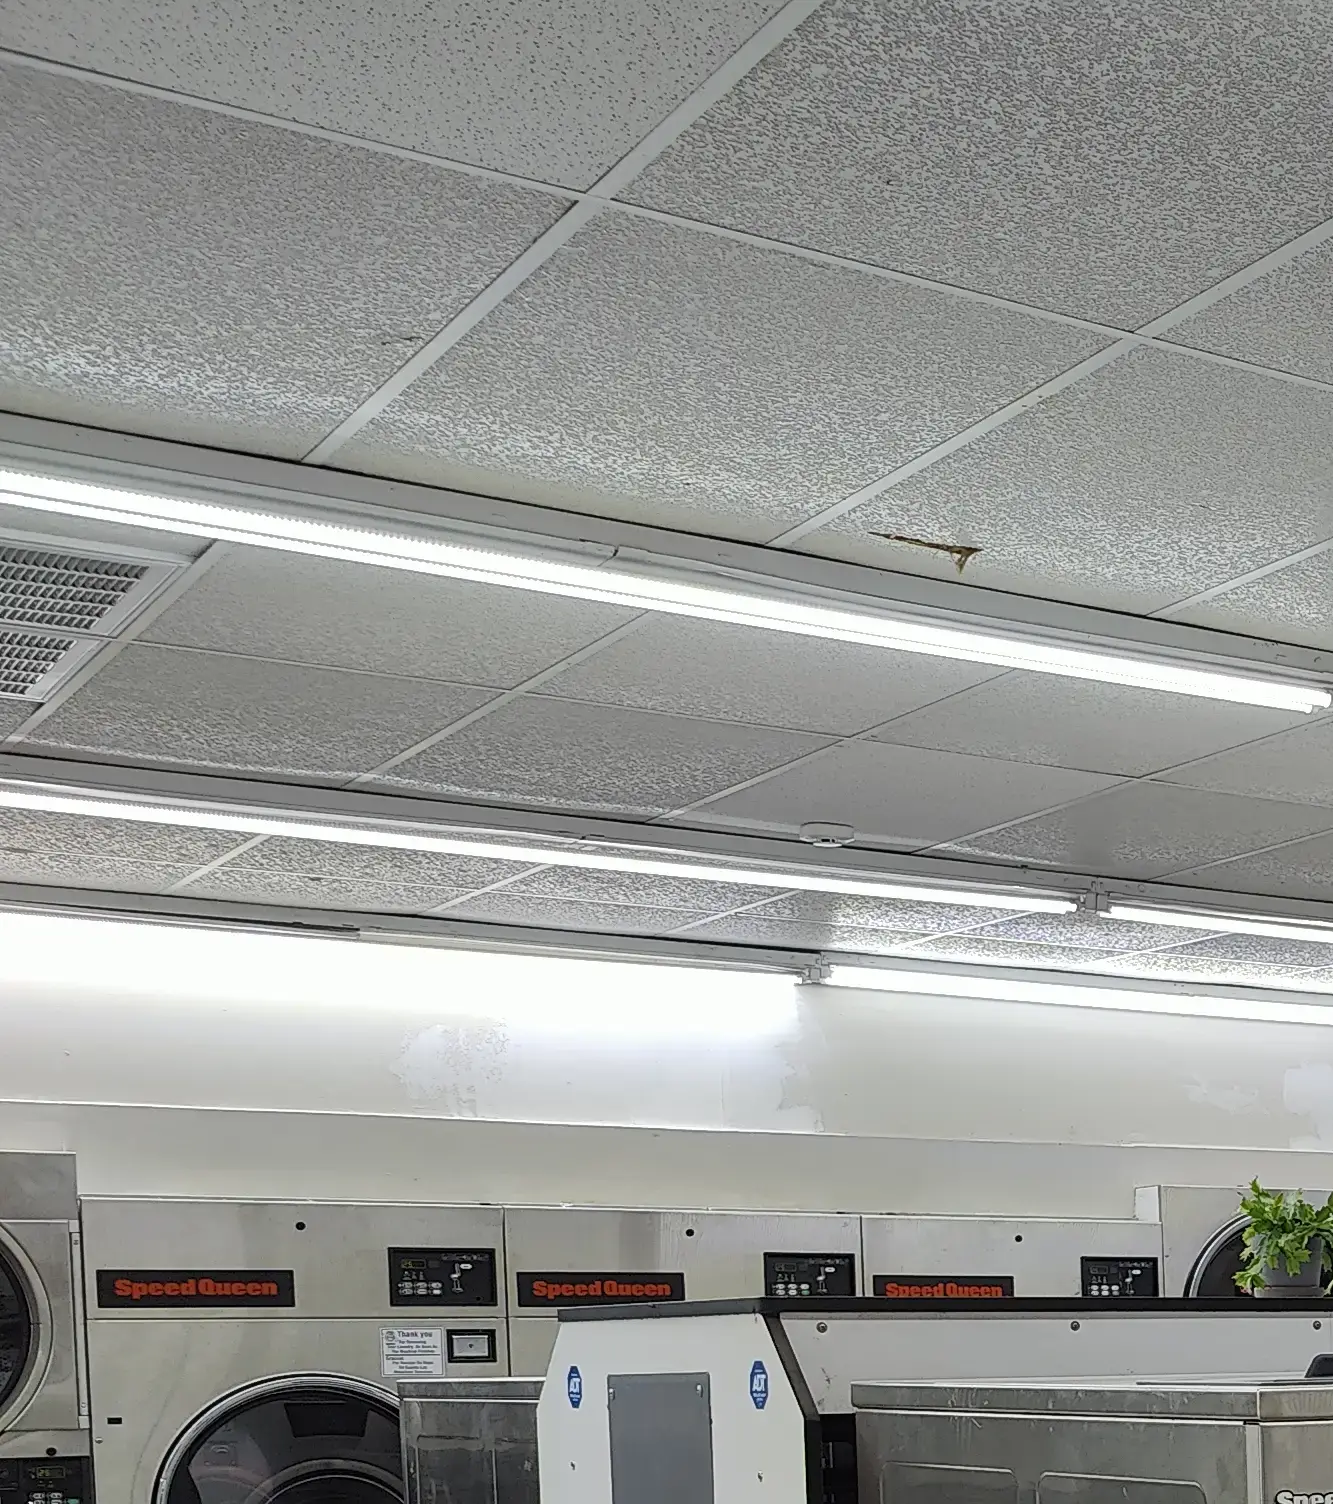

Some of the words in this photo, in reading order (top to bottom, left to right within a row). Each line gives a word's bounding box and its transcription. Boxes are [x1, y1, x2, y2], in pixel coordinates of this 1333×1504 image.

[114, 1278, 196, 1300] Speed
[198, 1278, 278, 1296] Queen
[532, 1281, 602, 1299] Speed
[603, 1281, 672, 1296] Queen
[945, 1282, 1003, 1297] Queen
[397, 1330, 418, 1338] Thank
